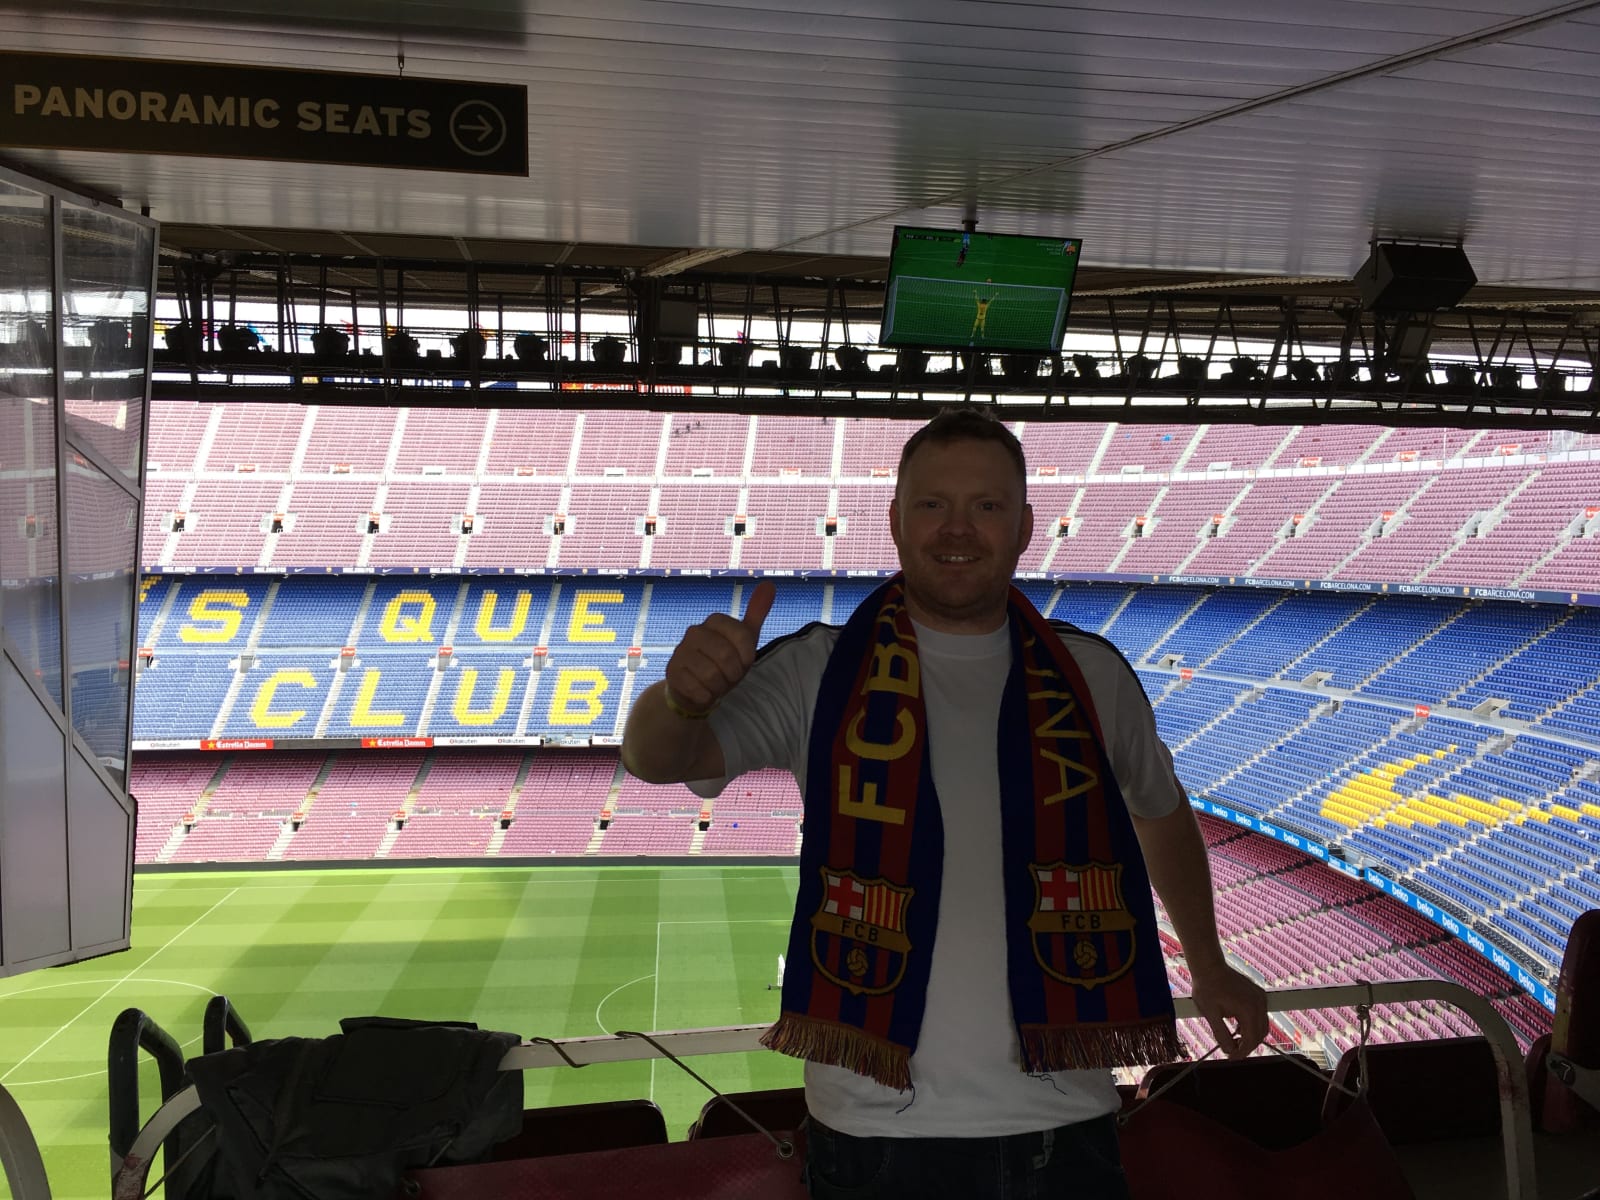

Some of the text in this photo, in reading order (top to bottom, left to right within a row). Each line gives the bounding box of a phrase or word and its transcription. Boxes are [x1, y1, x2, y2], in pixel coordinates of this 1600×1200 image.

[14, 83, 431, 140] PANORAMIC SEATS
[176, 588, 625, 643] S QUE
[248, 667, 609, 728] CLUB
[1212, 804, 1228, 818] beko
[1235, 813, 1252, 827] beko
[1259, 822, 1276, 837] beko
[1283, 831, 1300, 846] beko
[1307, 842, 1324, 857] beko
[1368, 871, 1384, 888] beko
[1391, 883, 1409, 902] beko
[1416, 898, 1434, 918] beko
[842, 919, 878, 942] FCB
[1062, 914, 1101, 929] FCB
[1442, 914, 1459, 934] beko
[1467, 930, 1485, 952] beko
[1492, 949, 1510, 972] beko
[1518, 969, 1536, 994] beko
